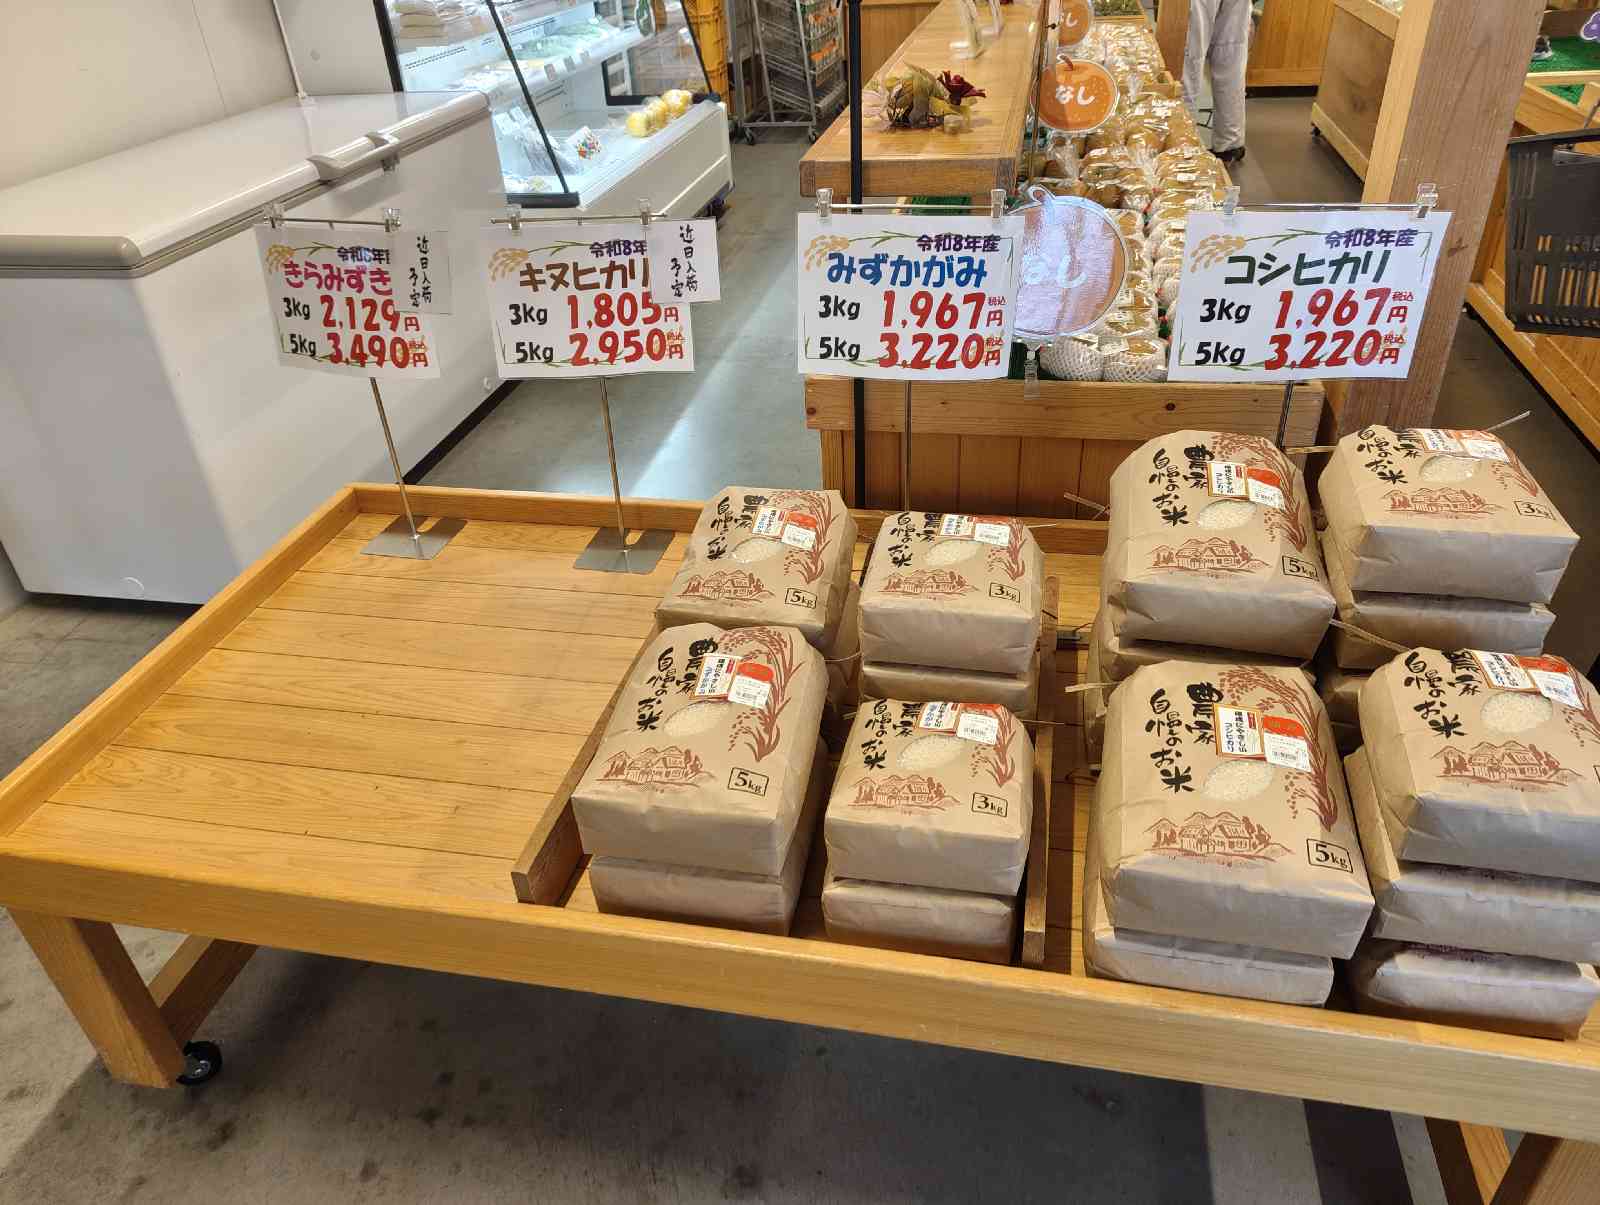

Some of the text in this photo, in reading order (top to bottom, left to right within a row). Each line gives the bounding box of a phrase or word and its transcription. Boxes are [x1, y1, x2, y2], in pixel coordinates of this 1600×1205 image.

[1056, 84, 1095, 105] なし
[915, 234, 1001, 253] 令和8年産
[1325, 229, 1418, 248] 令和8年産
[417, 236, 432, 304] 近日入荷
[520, 258, 650, 292] キヌヒカリ
[680, 224, 698, 292] 近日入荷
[827, 253, 987, 288] みずかがみ
[1224, 249, 1391, 286] コシヒカリ
[283, 261, 393, 296] きらみずき
[409, 268, 421, 307] 予定
[671, 258, 684, 297] 予定
[1149, 448, 1190, 526] 自慢のお米
[790, 591, 815, 607] 5kg
[636, 647, 677, 732] 自慢のお米
[1404, 651, 1466, 738] 自慢のお米
[861, 698, 892, 770] 自慢のお米
[1145, 688, 1196, 794] 自慢のお米
[734, 771, 763, 794] 5kg
[977, 795, 1004, 815] 3kg
[1315, 843, 1349, 869] 5kg
